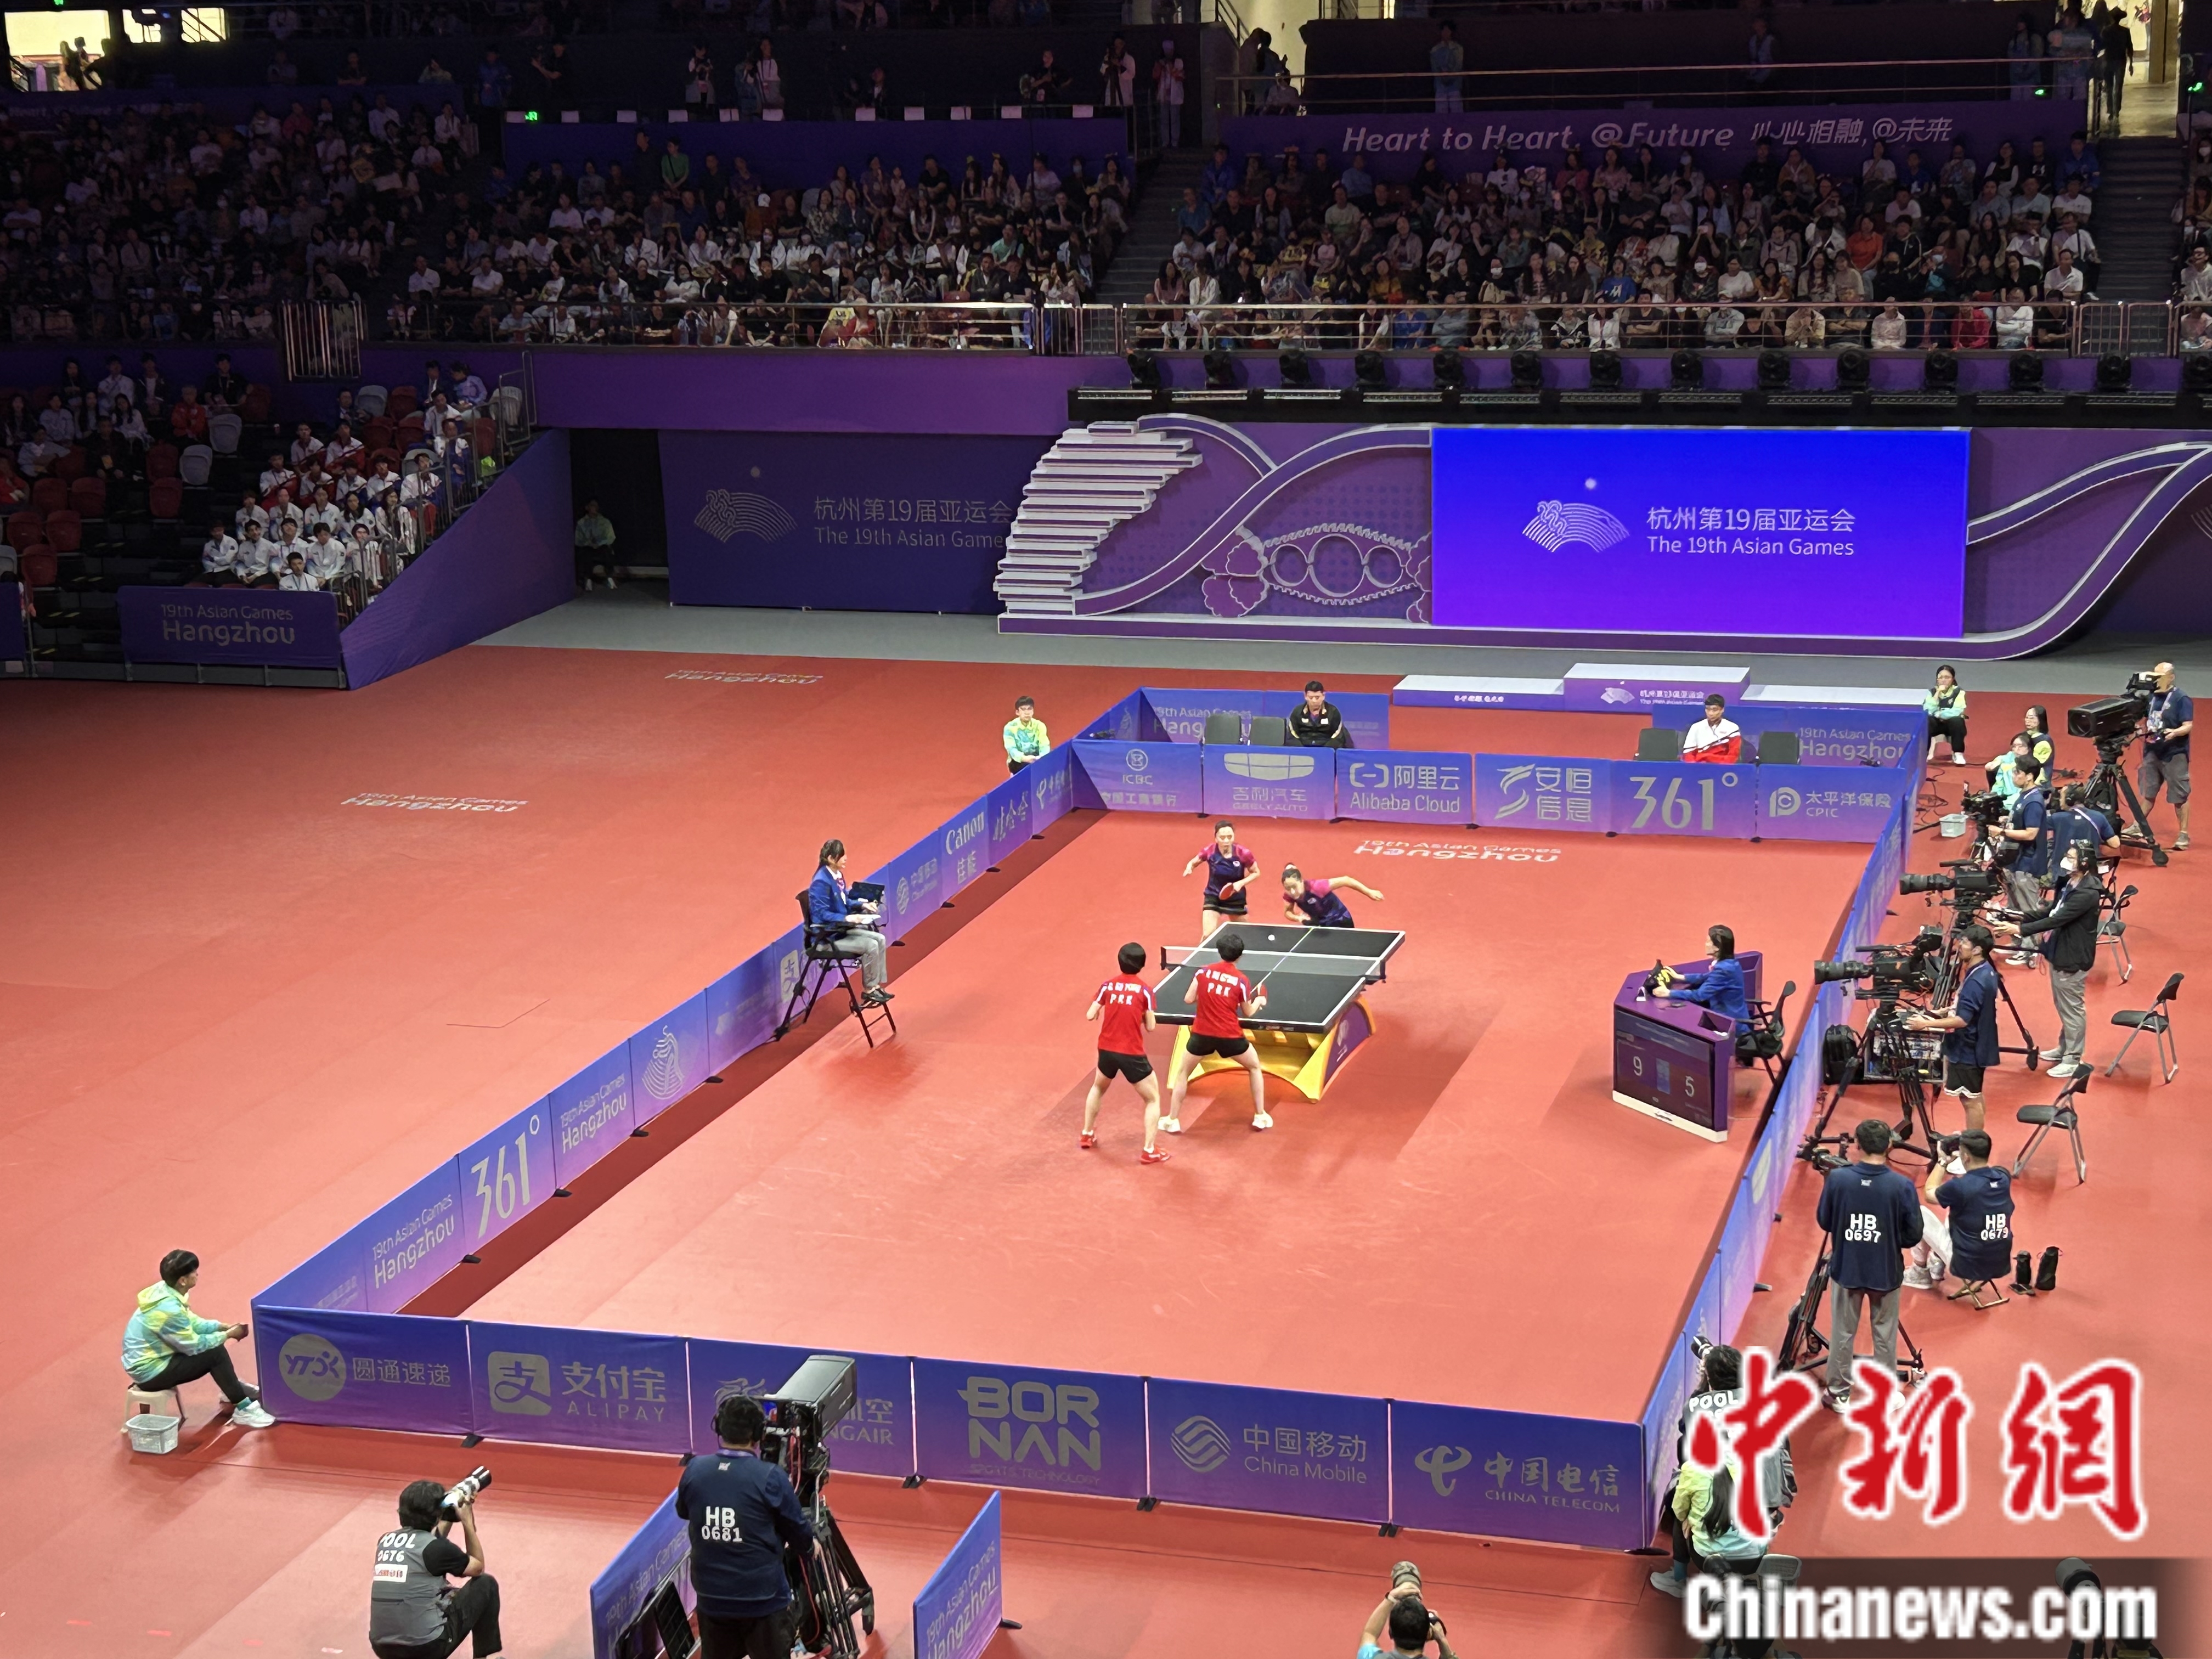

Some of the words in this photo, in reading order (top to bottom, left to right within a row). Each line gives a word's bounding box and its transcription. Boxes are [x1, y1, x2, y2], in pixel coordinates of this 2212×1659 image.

[1342, 127, 1430, 153] Heart
[1442, 127, 1473, 150] to
[1591, 122, 1734, 148] @Future
[814, 496, 1012, 524] 杭州第19届亚运会
[1646, 506, 1857, 532] 杭州第19届亚运会
[814, 527, 848, 544] The
[854, 528, 891, 546] 19th
[897, 530, 945, 547] Asian
[951, 531, 1004, 549] Game
[1646, 535, 1682, 553] The
[1687, 537, 1727, 554] 19th
[1731, 538, 1784, 555] Asian
[1788, 539, 1854, 556] Games
[161, 603, 193, 618] 19th
[196, 605, 239, 619] Asian
[240, 606, 294, 620] Games
[162, 619, 295, 646] Hangzhou
[1122, 774, 1153, 785] ICBC
[1393, 765, 1460, 791] 阿里云
[1350, 792, 1410, 811] Alibaba
[1415, 794, 1460, 813] Cloud
[1629, 771, 1739, 831] 361°
[1805, 808, 1839, 818] CPIC
[945, 811, 985, 855] Canon
[1353, 845, 1559, 862] Hangzhou
[1109, 993, 1133, 1006] PRK
[1633, 1056, 1643, 1077] 9
[1685, 1075, 1695, 1098] 5
[562, 1092, 627, 1154] Hangzhou
[471, 1114, 541, 1239] 361°
[421, 1193, 453, 1225] Games
[1850, 1213, 1878, 1231] HB
[1985, 1213, 2007, 1231] HB
[1844, 1228, 1882, 1243] 0697
[374, 1214, 455, 1289] Hangzhou
[352, 1357, 452, 1387] 圆通速递
[560, 1361, 667, 1403] 支付宝
[567, 1401, 665, 1423] ALIPAY
[957, 1376, 1100, 1428] BOR
[1688, 1390, 1739, 1413] POOL
[1243, 1424, 1368, 1464] 中国移动
[1244, 1454, 1300, 1478] China
[1304, 1459, 1368, 1485] Mobile
[1483, 1451, 1621, 1498] 中国电信
[1484, 1488, 1537, 1504] CHINA
[1542, 1494, 1621, 1514] TELECOM
[704, 1505, 736, 1528] HB
[701, 1524, 743, 1543] 0681
